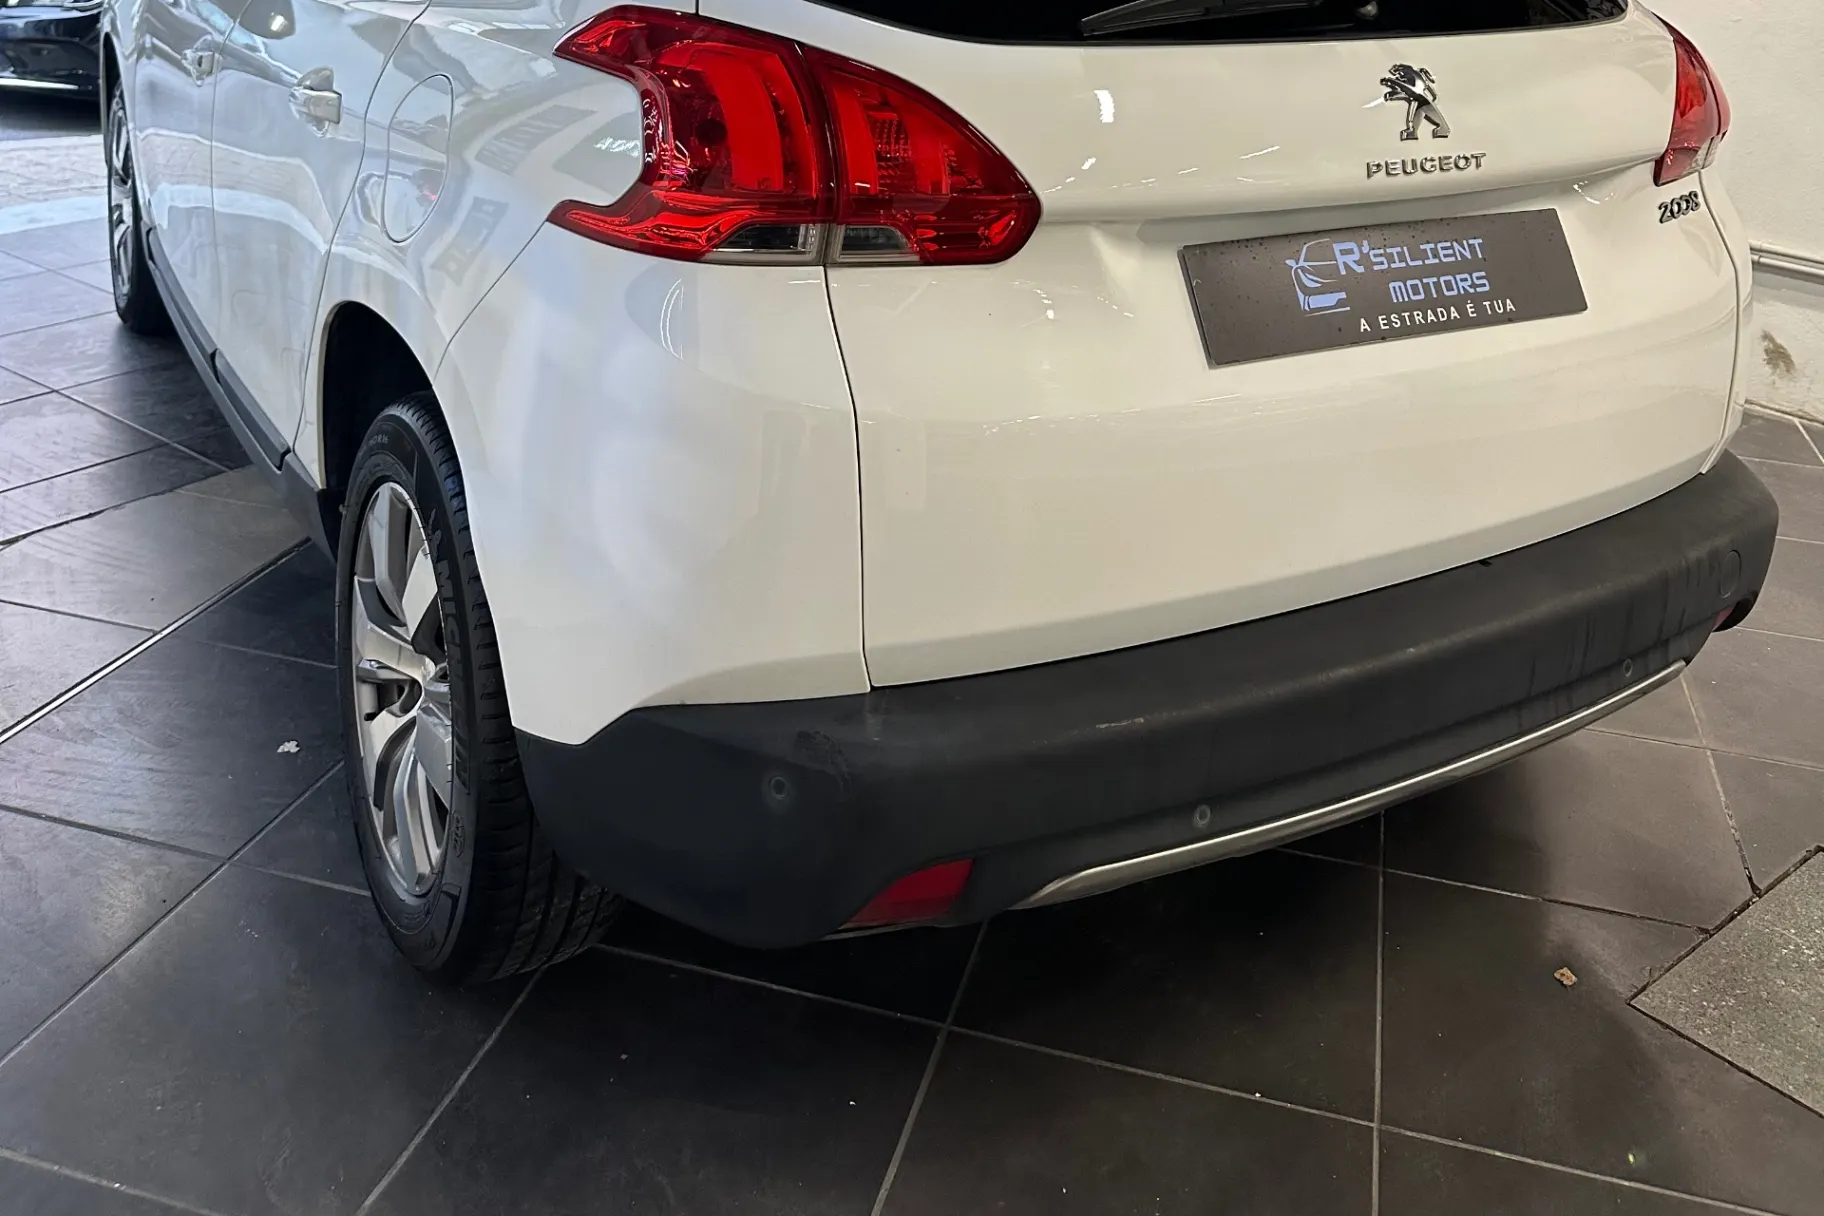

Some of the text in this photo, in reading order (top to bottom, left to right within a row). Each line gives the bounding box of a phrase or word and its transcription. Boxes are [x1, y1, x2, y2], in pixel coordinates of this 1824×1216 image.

[1366, 152, 1486, 179] PEUGEOT
[1658, 190, 1702, 224] 2008
[1388, 272, 1490, 303] MOTORS
[1360, 298, 1516, 332] A ESTRADA É TUA
